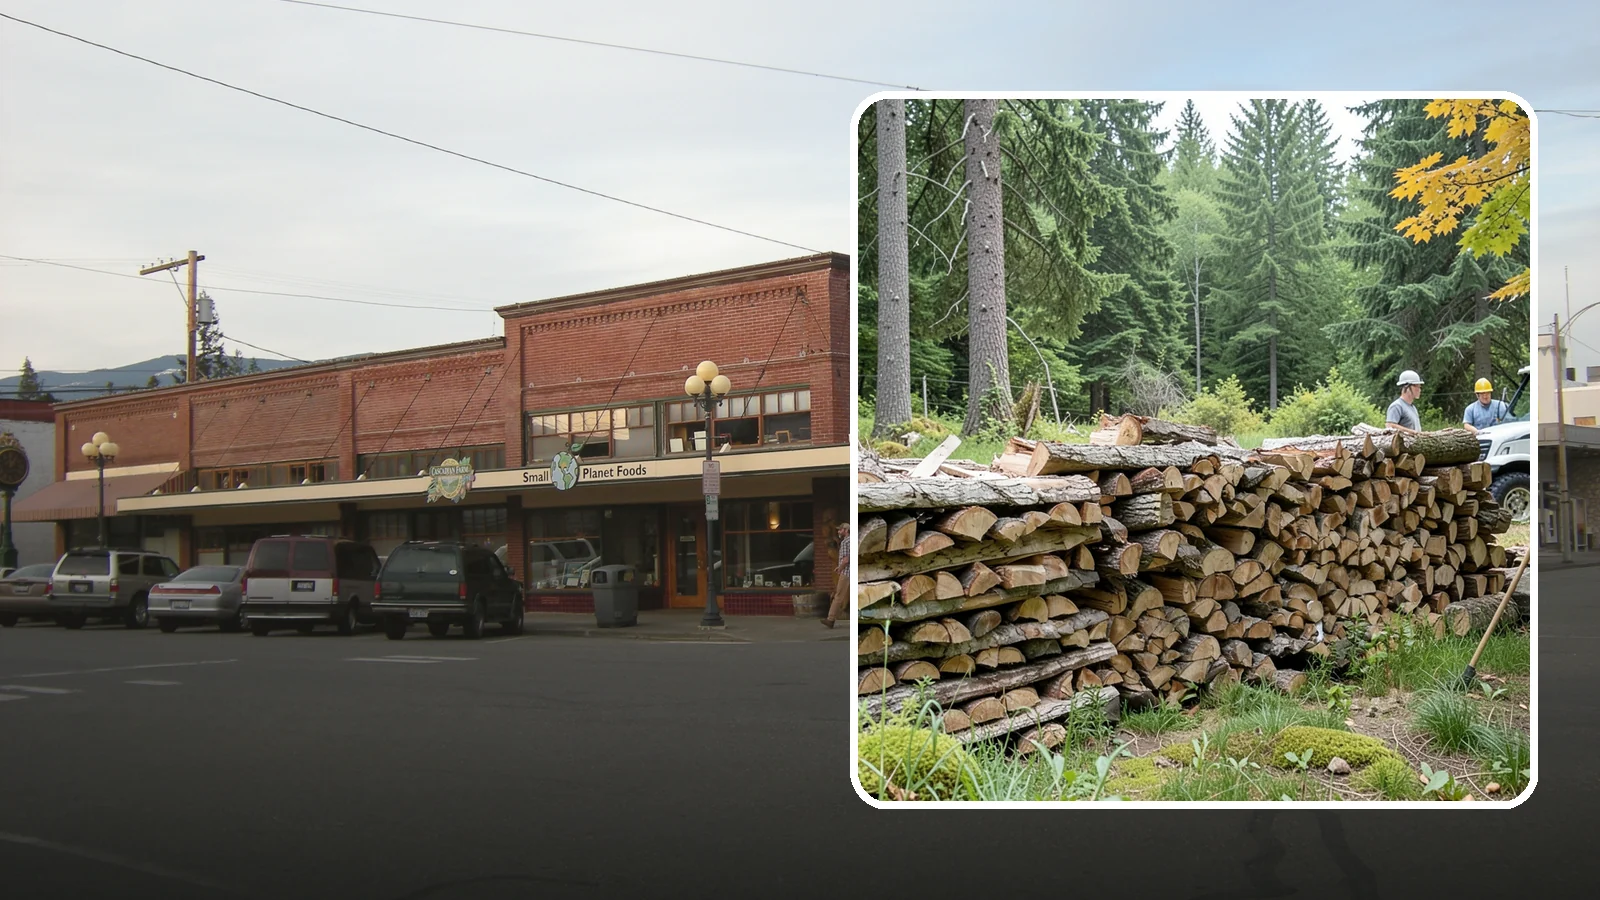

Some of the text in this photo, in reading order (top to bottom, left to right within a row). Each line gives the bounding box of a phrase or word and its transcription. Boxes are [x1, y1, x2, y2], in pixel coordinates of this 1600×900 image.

[523, 464, 647, 483] Small Planet Foods
